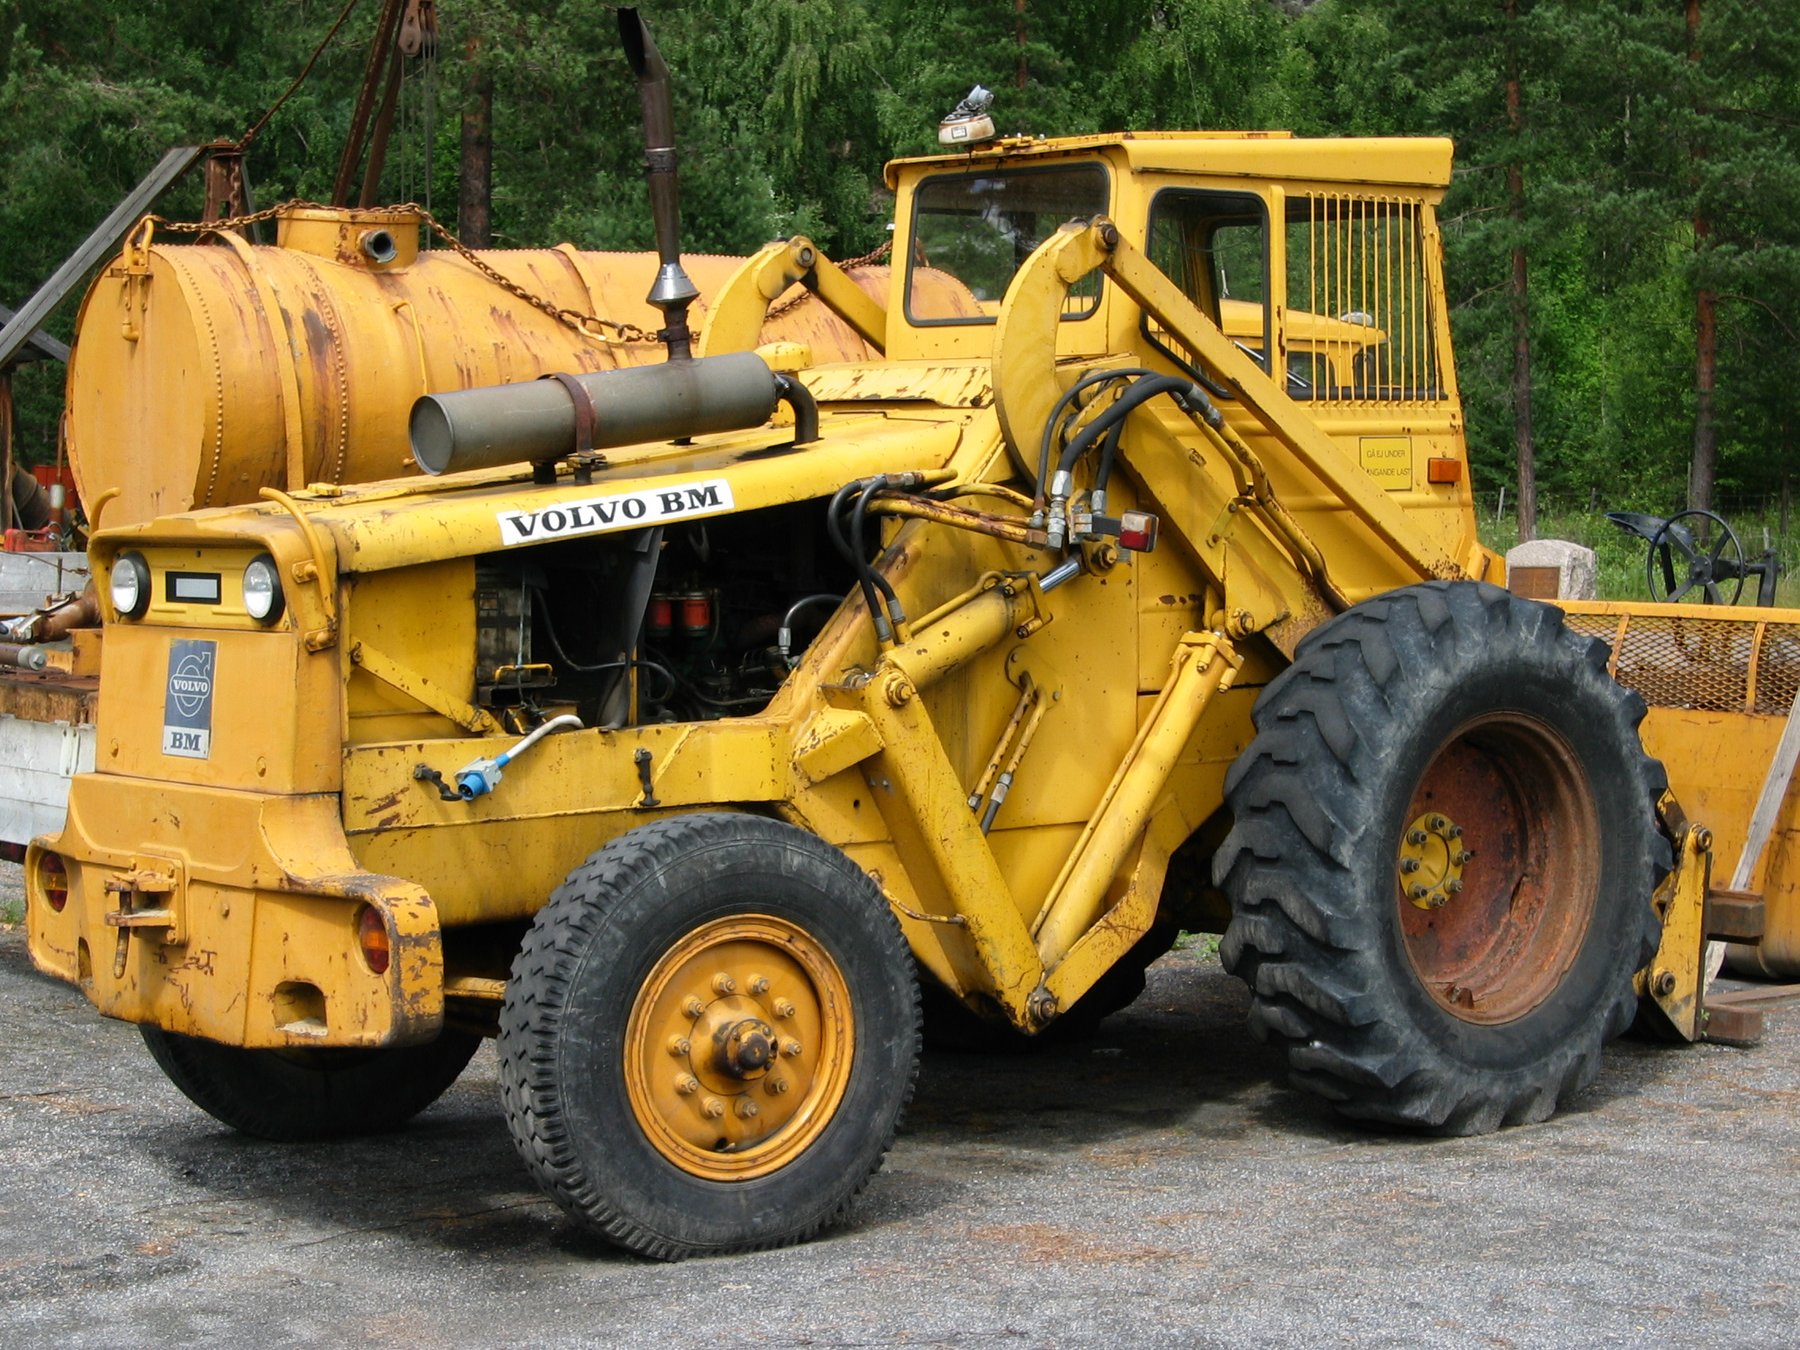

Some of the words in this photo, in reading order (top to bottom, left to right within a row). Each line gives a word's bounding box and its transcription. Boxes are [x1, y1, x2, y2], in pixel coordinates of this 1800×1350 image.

[1376, 449, 1384, 458] EJ
[1384, 449, 1406, 458] UNDER
[1396, 467, 1411, 477] LAST
[506, 498, 647, 537] VOLVO
[656, 485, 723, 515] BM
[173, 679, 208, 693] VOLVO
[170, 731, 202, 752] BM
